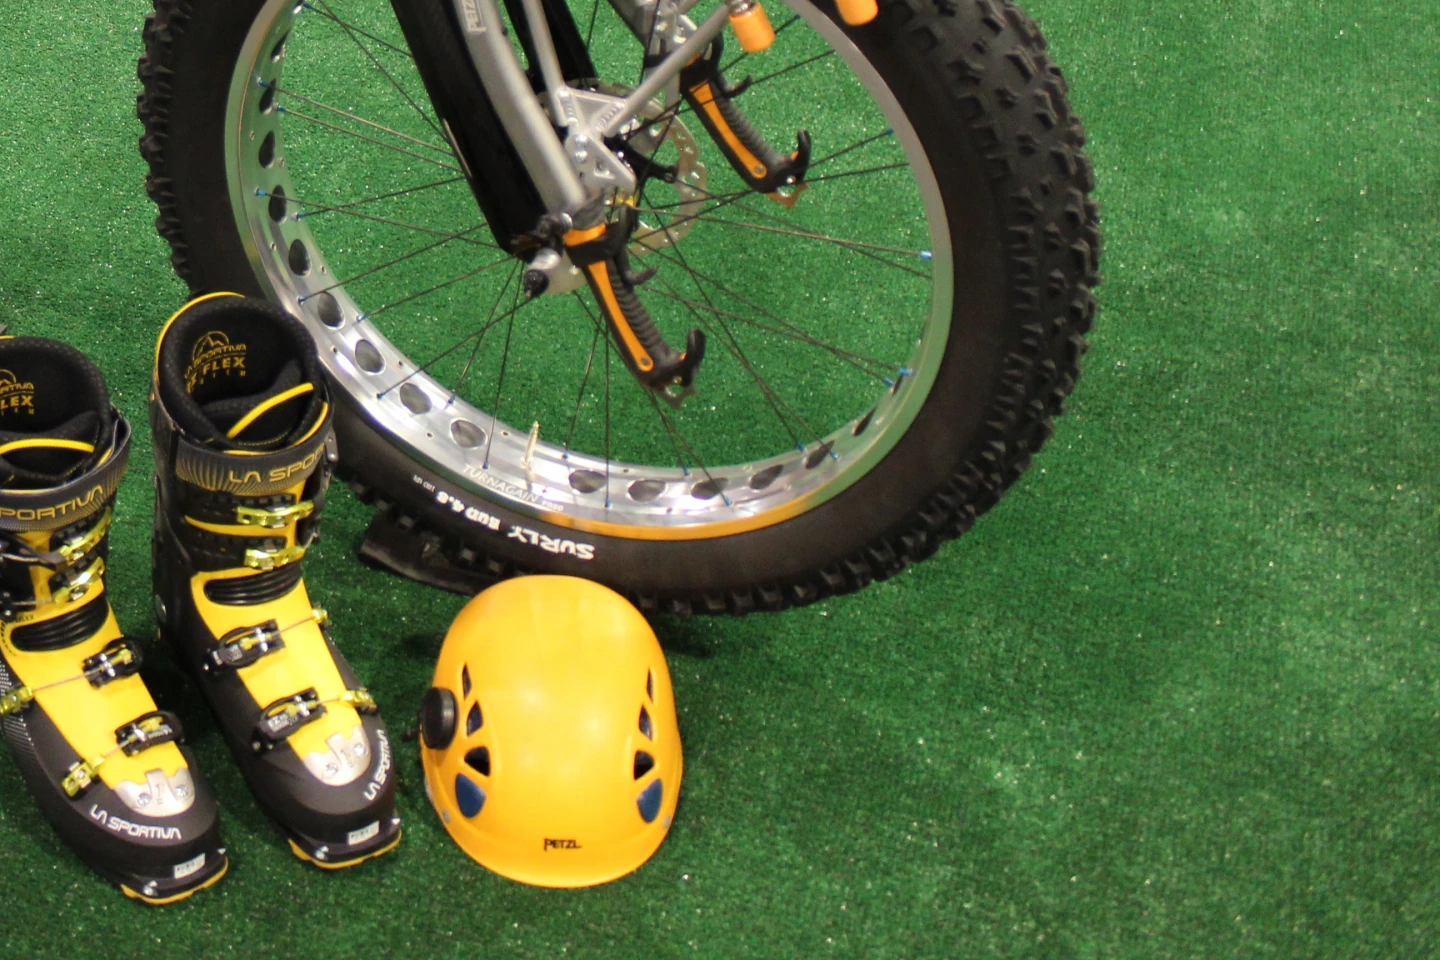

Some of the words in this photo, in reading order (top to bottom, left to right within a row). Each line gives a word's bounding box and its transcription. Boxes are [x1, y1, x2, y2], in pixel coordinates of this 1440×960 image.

[202, 356, 247, 376] FLEX
[229, 470, 262, 484] LA
[462, 462, 540, 505] TURNAGAIN
[465, 506, 502, 532] BUD
[507, 525, 597, 561] SURLY
[89, 802, 108, 825] LA
[107, 816, 183, 841] SPORTIVA
[543, 837, 584, 852] PETZL
